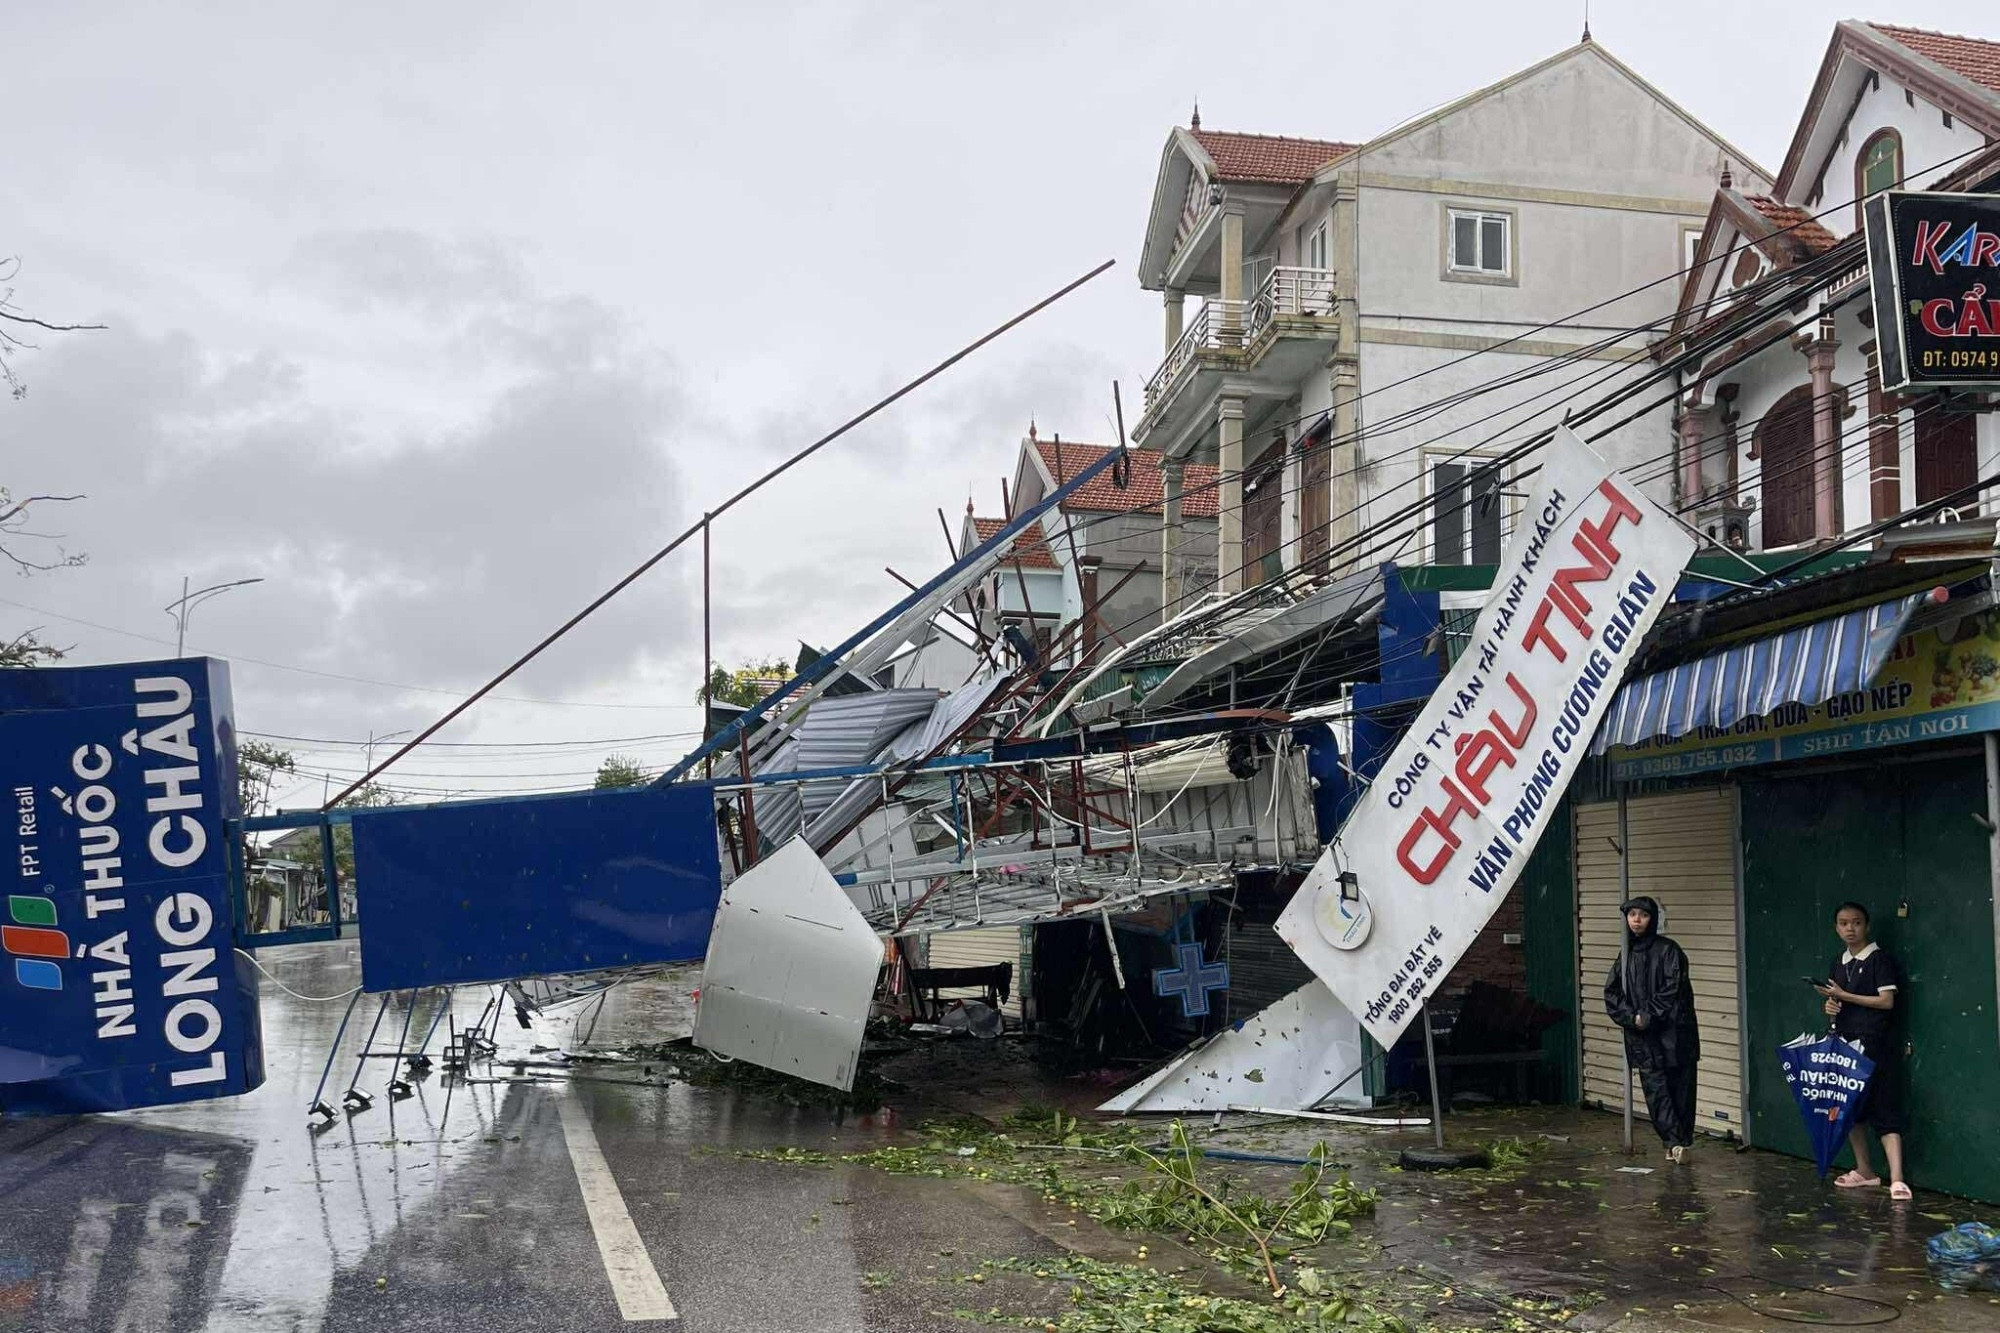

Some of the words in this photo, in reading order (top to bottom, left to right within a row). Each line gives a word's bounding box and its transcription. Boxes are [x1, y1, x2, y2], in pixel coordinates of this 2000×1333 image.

[1923, 351, 1947, 367] ĐT:
[1951, 350, 1986, 367] 0974
[1388, 751, 1430, 808] CÔNG
[1426, 720, 1451, 749] TY
[1448, 675, 1484, 719] VẬN
[1479, 639, 1499, 674] TẢI
[1493, 574, 1528, 640] HÀNH
[1521, 488, 1566, 574] KHÁCH
[1396, 672, 1538, 885] CHÂU
[1521, 478, 1644, 664] TỊNH
[1468, 835, 1514, 893] VĂN
[1502, 749, 1562, 845] PHÒNG
[1551, 648, 1612, 754] CƯƠNG
[1602, 569, 1657, 655] GIÁN
[1803, 732, 1853, 754] SHIP
[1861, 722, 1911, 746] TẬN
[1920, 714, 1969, 736] NƠI
[1826, 692, 1866, 721] GẠO
[1871, 677, 1913, 712] NẾP
[122, 675, 207, 868] CHÂU
[1642, 745, 1757, 774] 0369.755.032
[14, 786, 37, 836] Retail
[50, 743, 125, 920] THUỐC
[20, 844, 41, 877] FPT
[76, 930, 137, 1039] NHÀ
[155, 891, 228, 1088] LONG
[1364, 990, 1392, 1025] TỔNG
[1388, 969, 1409, 994] ĐÀI
[1404, 944, 1427, 973] ĐẶT
[1388, 999, 1410, 1025] 1900
[1406, 977, 1427, 1001] 252
[1422, 955, 1444, 979] 555
